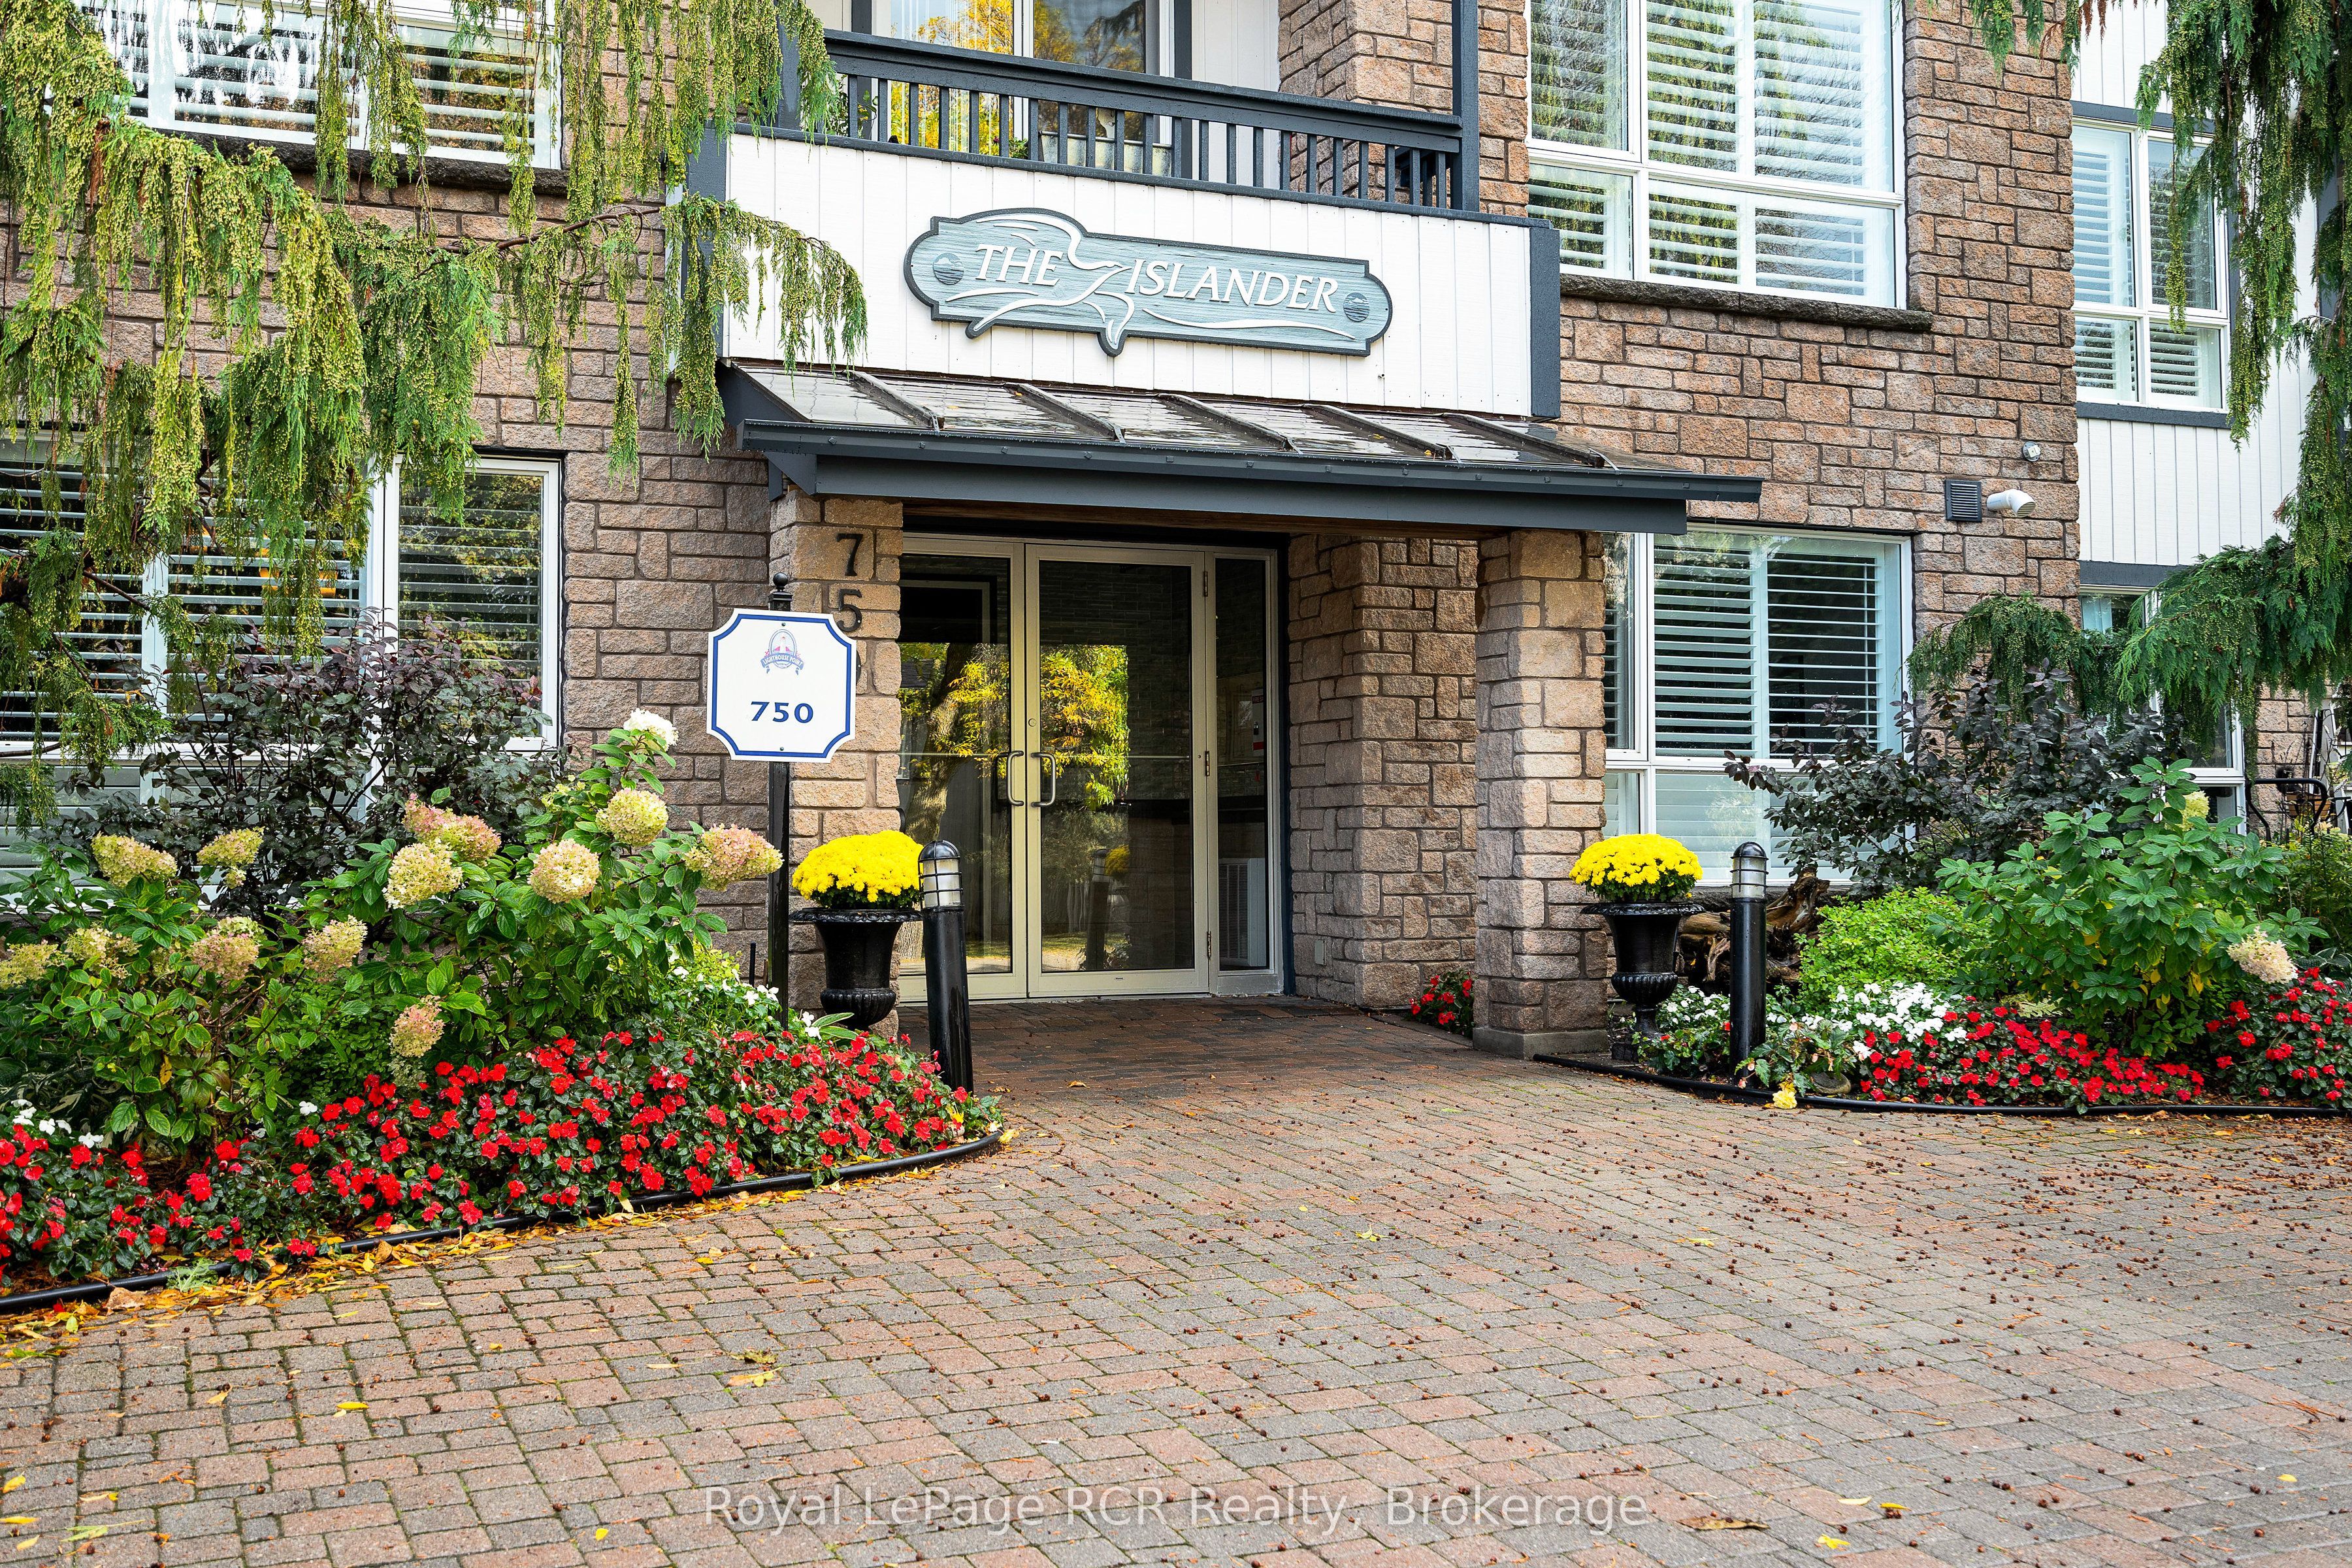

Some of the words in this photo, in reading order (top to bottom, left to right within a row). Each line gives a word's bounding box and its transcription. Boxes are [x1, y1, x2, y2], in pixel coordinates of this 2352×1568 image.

[975, 244, 1063, 287] THE
[1124, 259, 1339, 313] ISLANDER
[836, 533, 864, 685] 75
[762, 655, 789, 664] LIGHTHOUSE
[751, 701, 813, 723] 750
